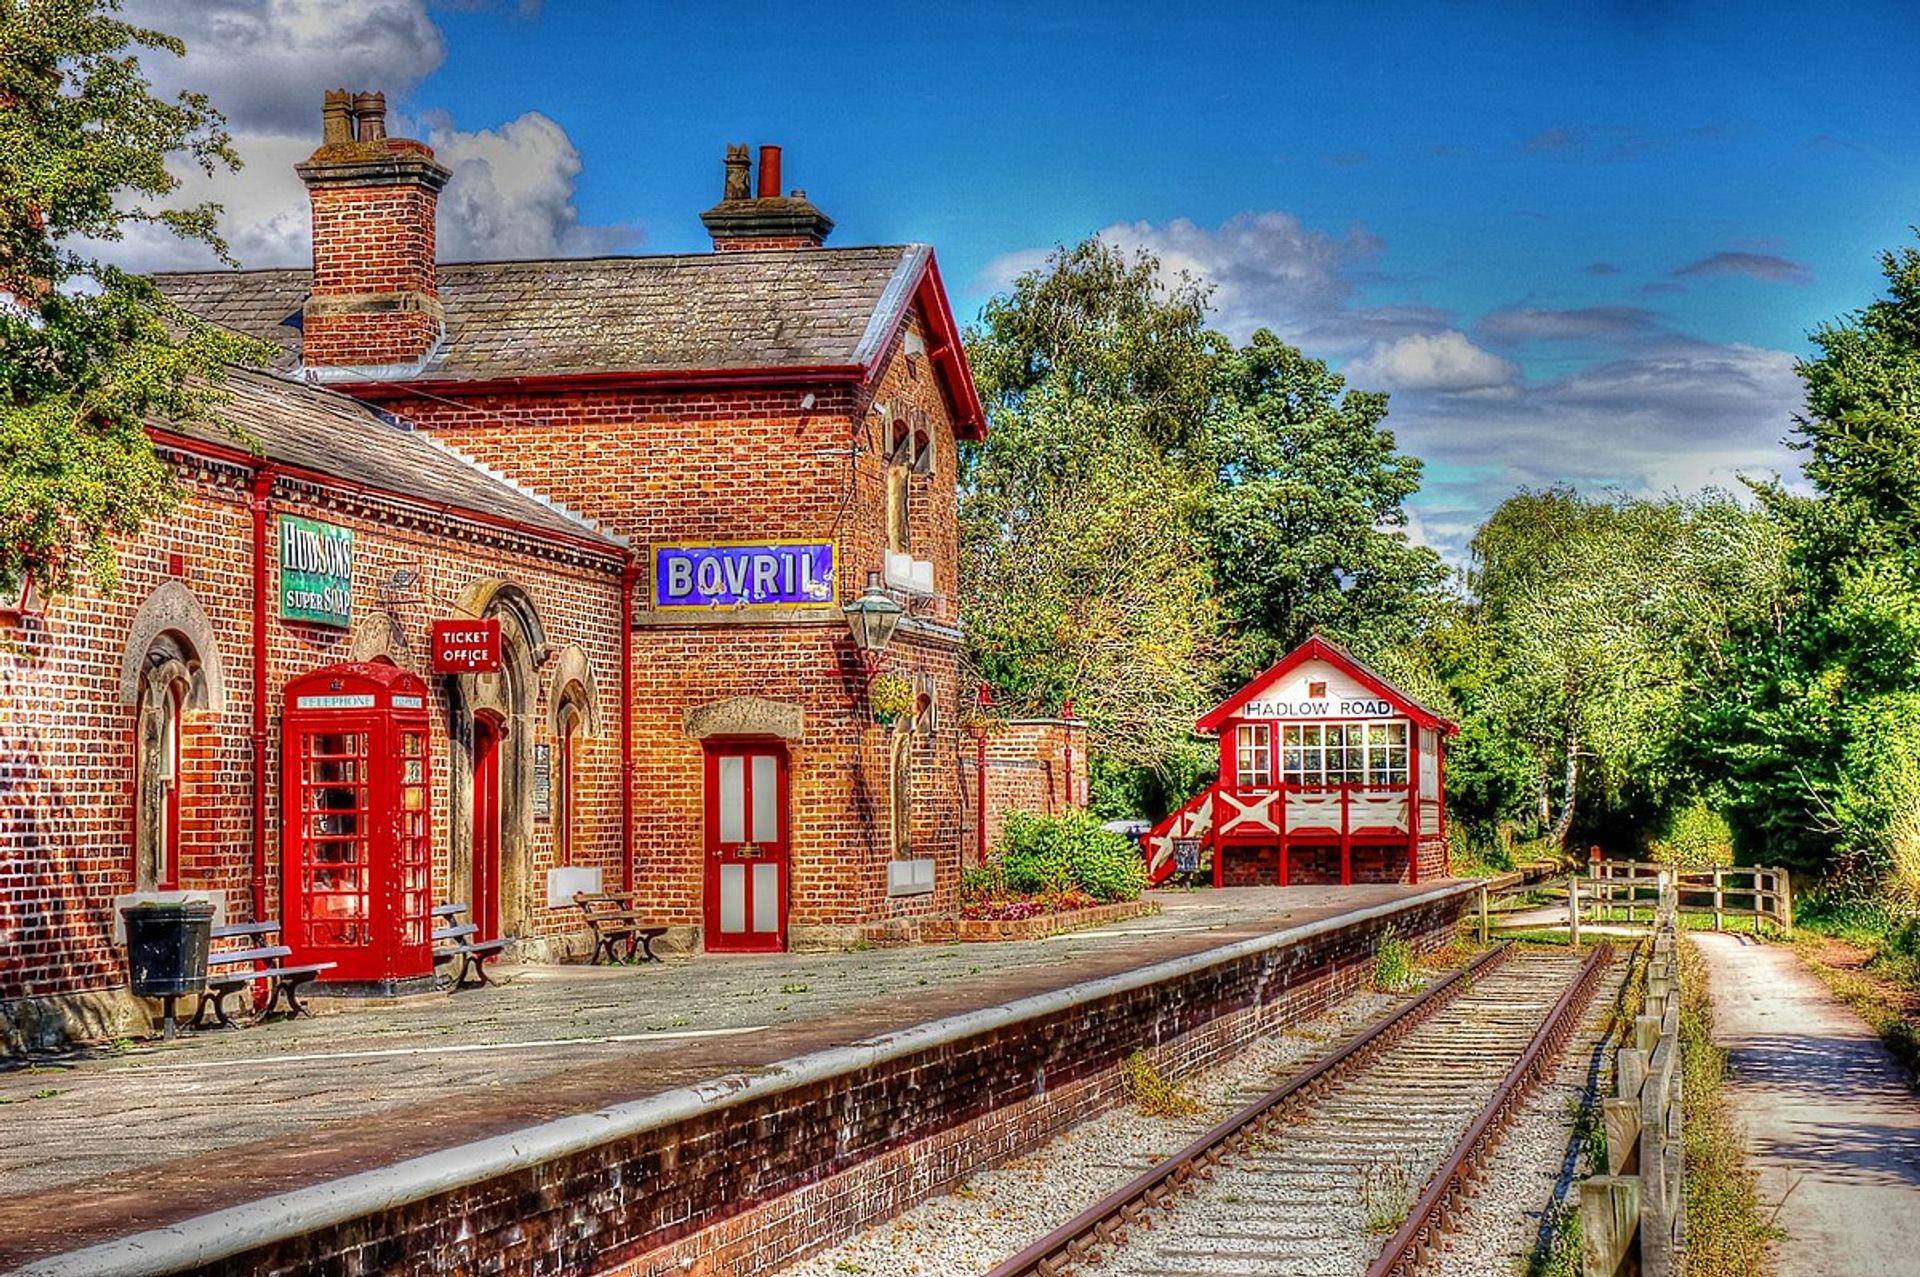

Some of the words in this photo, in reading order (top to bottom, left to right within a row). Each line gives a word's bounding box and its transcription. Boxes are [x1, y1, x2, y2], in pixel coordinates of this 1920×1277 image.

[668, 553, 829, 598] BOVRIL
[286, 590, 323, 611] SUPER
[324, 586, 350, 615] SOAP
[442, 632, 489, 643] TICKET
[443, 650, 488, 661] OFFICE
[299, 696, 373, 706] TELEPHONE
[1246, 702, 1329, 716] HADLOW
[1340, 701, 1390, 715] ROAD
